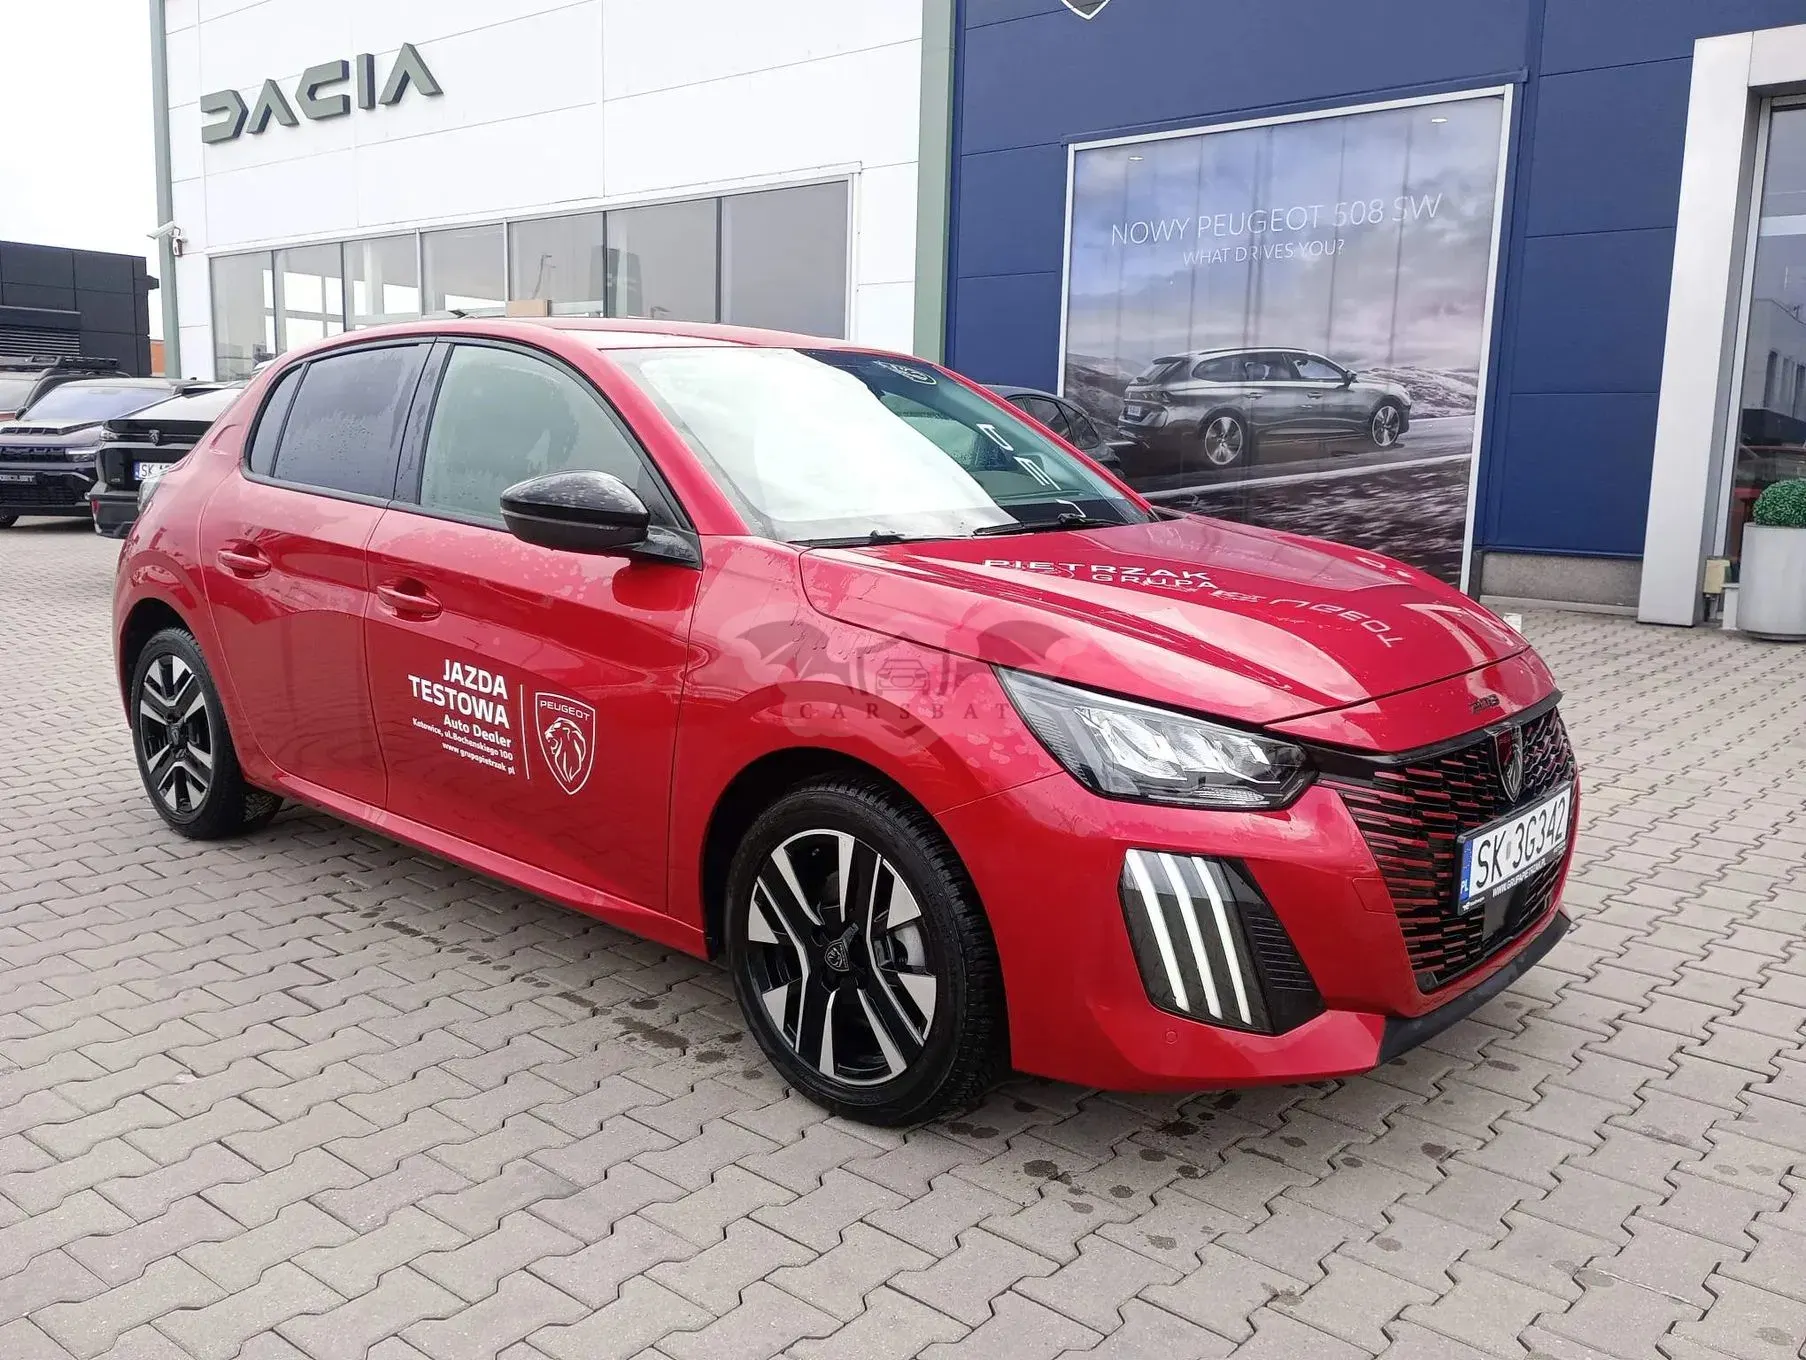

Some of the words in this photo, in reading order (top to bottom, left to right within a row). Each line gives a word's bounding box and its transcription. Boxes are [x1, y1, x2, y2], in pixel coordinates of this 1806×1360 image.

[201, 42, 443, 144] DACIA
[1111, 217, 1190, 246] NOWY
[1197, 204, 1324, 238] PEUGEOT
[1334, 199, 1384, 227] 508
[1393, 193, 1443, 222] SW
[1183, 249, 1230, 266] WHAT
[1234, 244, 1294, 262] DRIVES
[1299, 239, 1345, 258] YOU?
[984, 559, 1212, 582] PIETRZAK
[443, 659, 508, 700] JAZDA
[408, 674, 510, 729] TESTOWA
[540, 700, 590, 721] PEUGEOT
[444, 714, 470, 734] Auto
[473, 724, 512, 748] Dealer
[500, 749, 514, 761] 100
[1476, 830, 1507, 888] SK
[1512, 796, 1566, 869] 3G342
